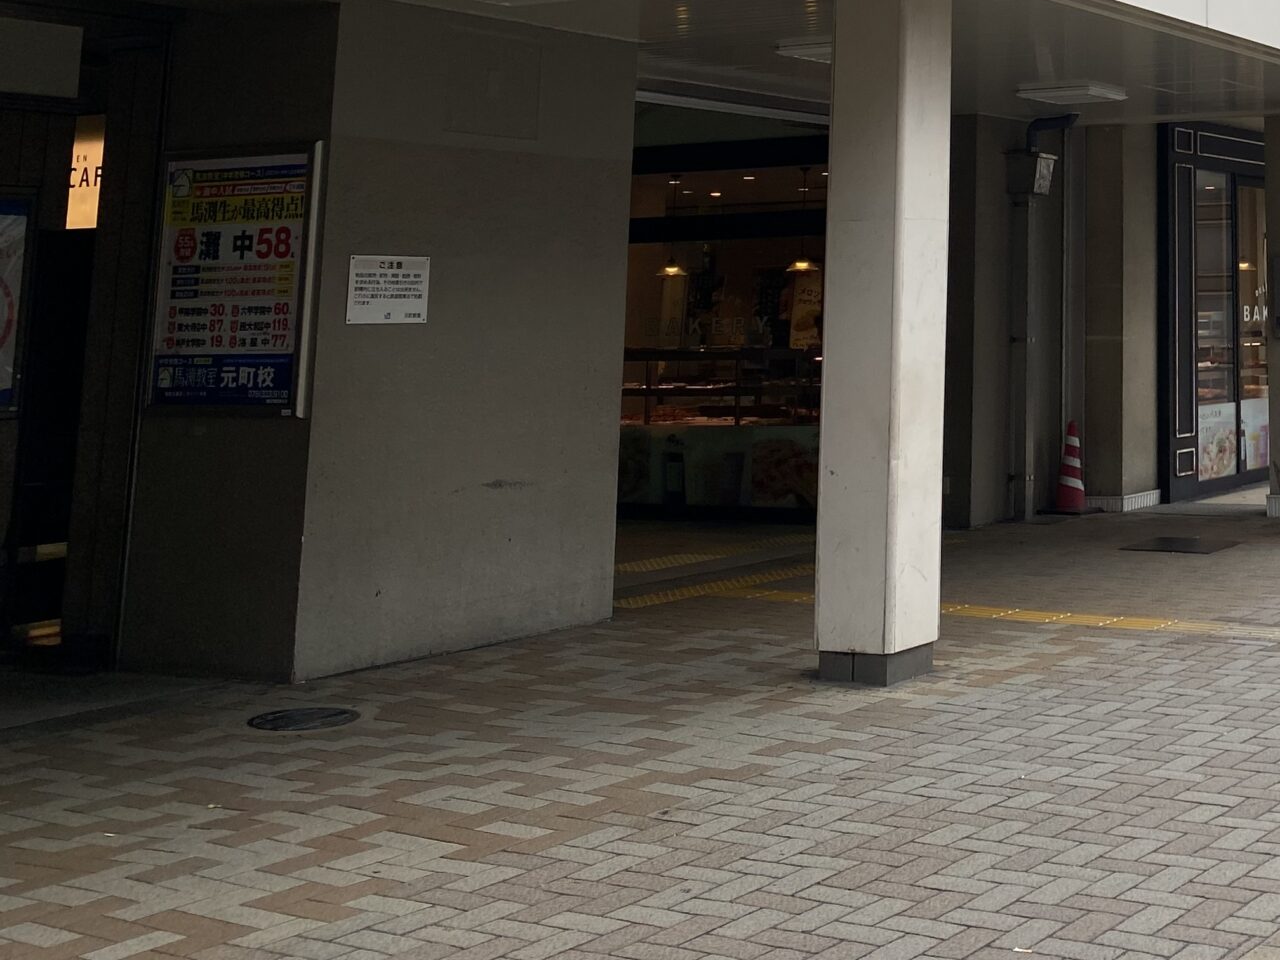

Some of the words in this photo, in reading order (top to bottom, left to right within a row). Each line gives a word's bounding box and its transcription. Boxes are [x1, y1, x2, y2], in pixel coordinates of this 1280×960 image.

[256, 226, 291, 259] 58
[210, 303, 225, 316] 30
[274, 302, 289, 315] 60
[209, 319, 223, 332] 87
[272, 318, 288, 331] 119
[644, 316, 769, 337] BAKERY
[210, 335, 223, 347] 19
[272, 334, 287, 347] 77
[220, 366, 275, 387] 元町校
